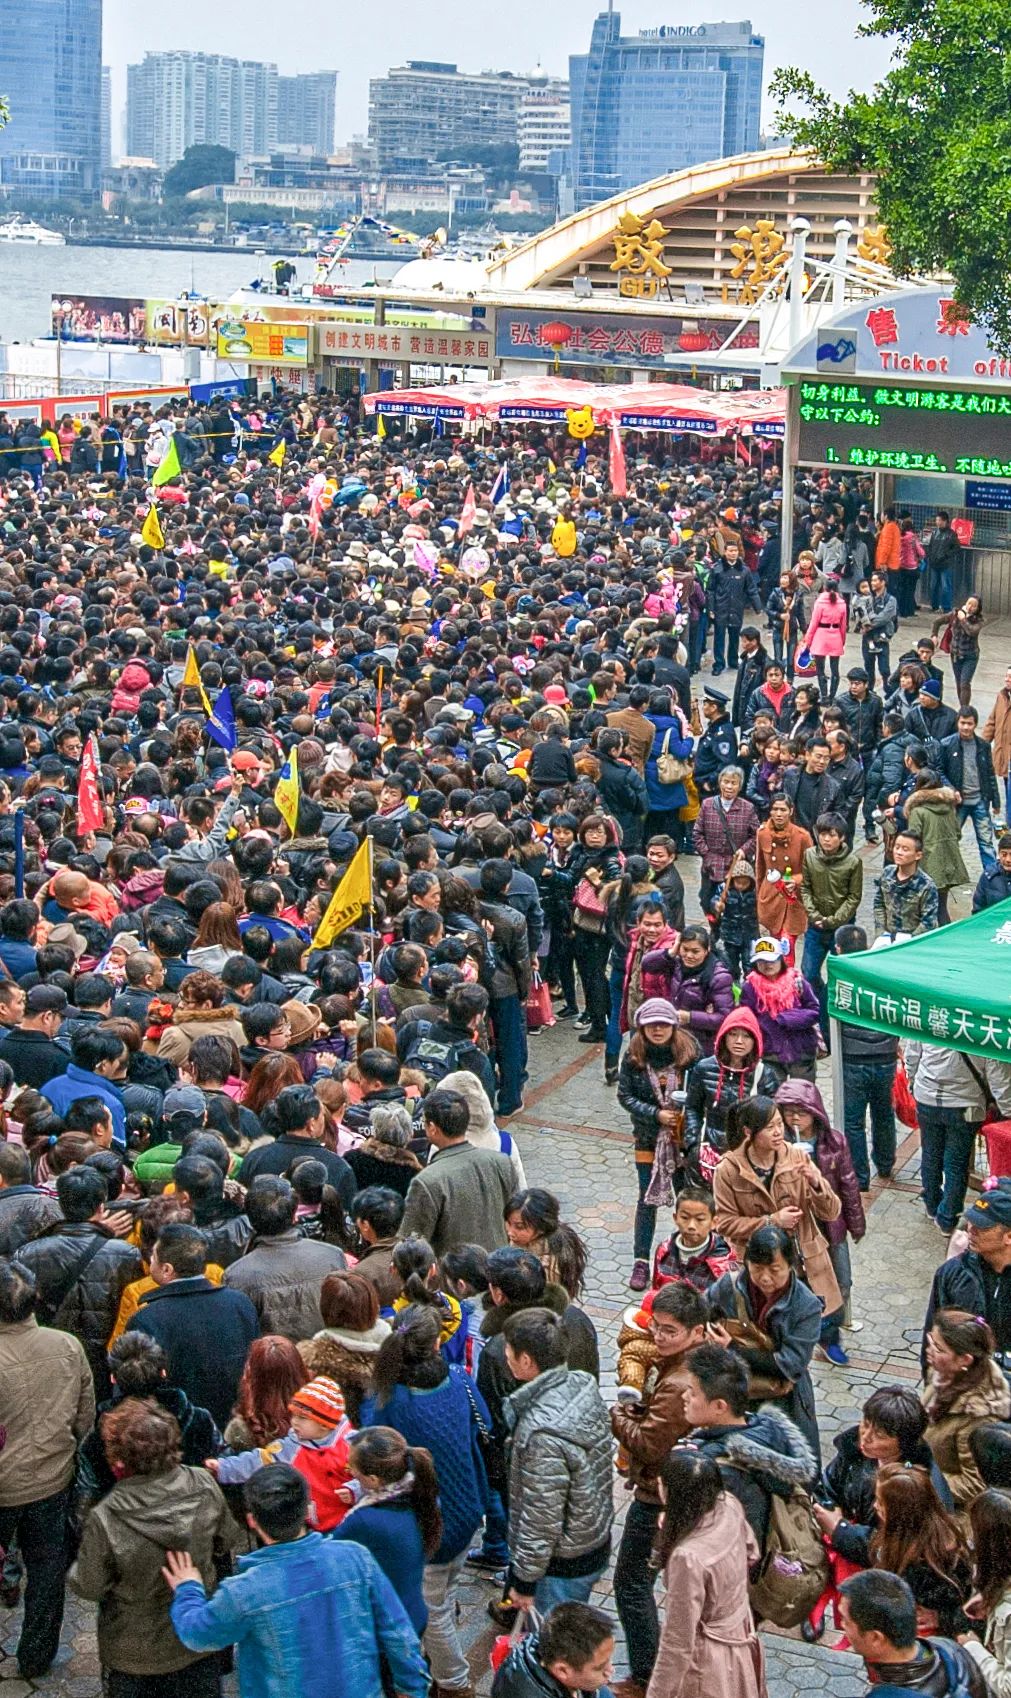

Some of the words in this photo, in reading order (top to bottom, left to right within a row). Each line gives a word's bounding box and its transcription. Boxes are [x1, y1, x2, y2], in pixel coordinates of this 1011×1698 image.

[639, 27, 658, 37] hotel
[667, 25, 706, 37] INDIGO
[620, 276, 657, 298] GU
[324, 330, 402, 353] 创建文明城市
[409, 336, 490, 359] 营造温馨家园
[878, 352, 949, 374] Ticket
[834, 979, 1011, 1051] 厦门市温馨天天
